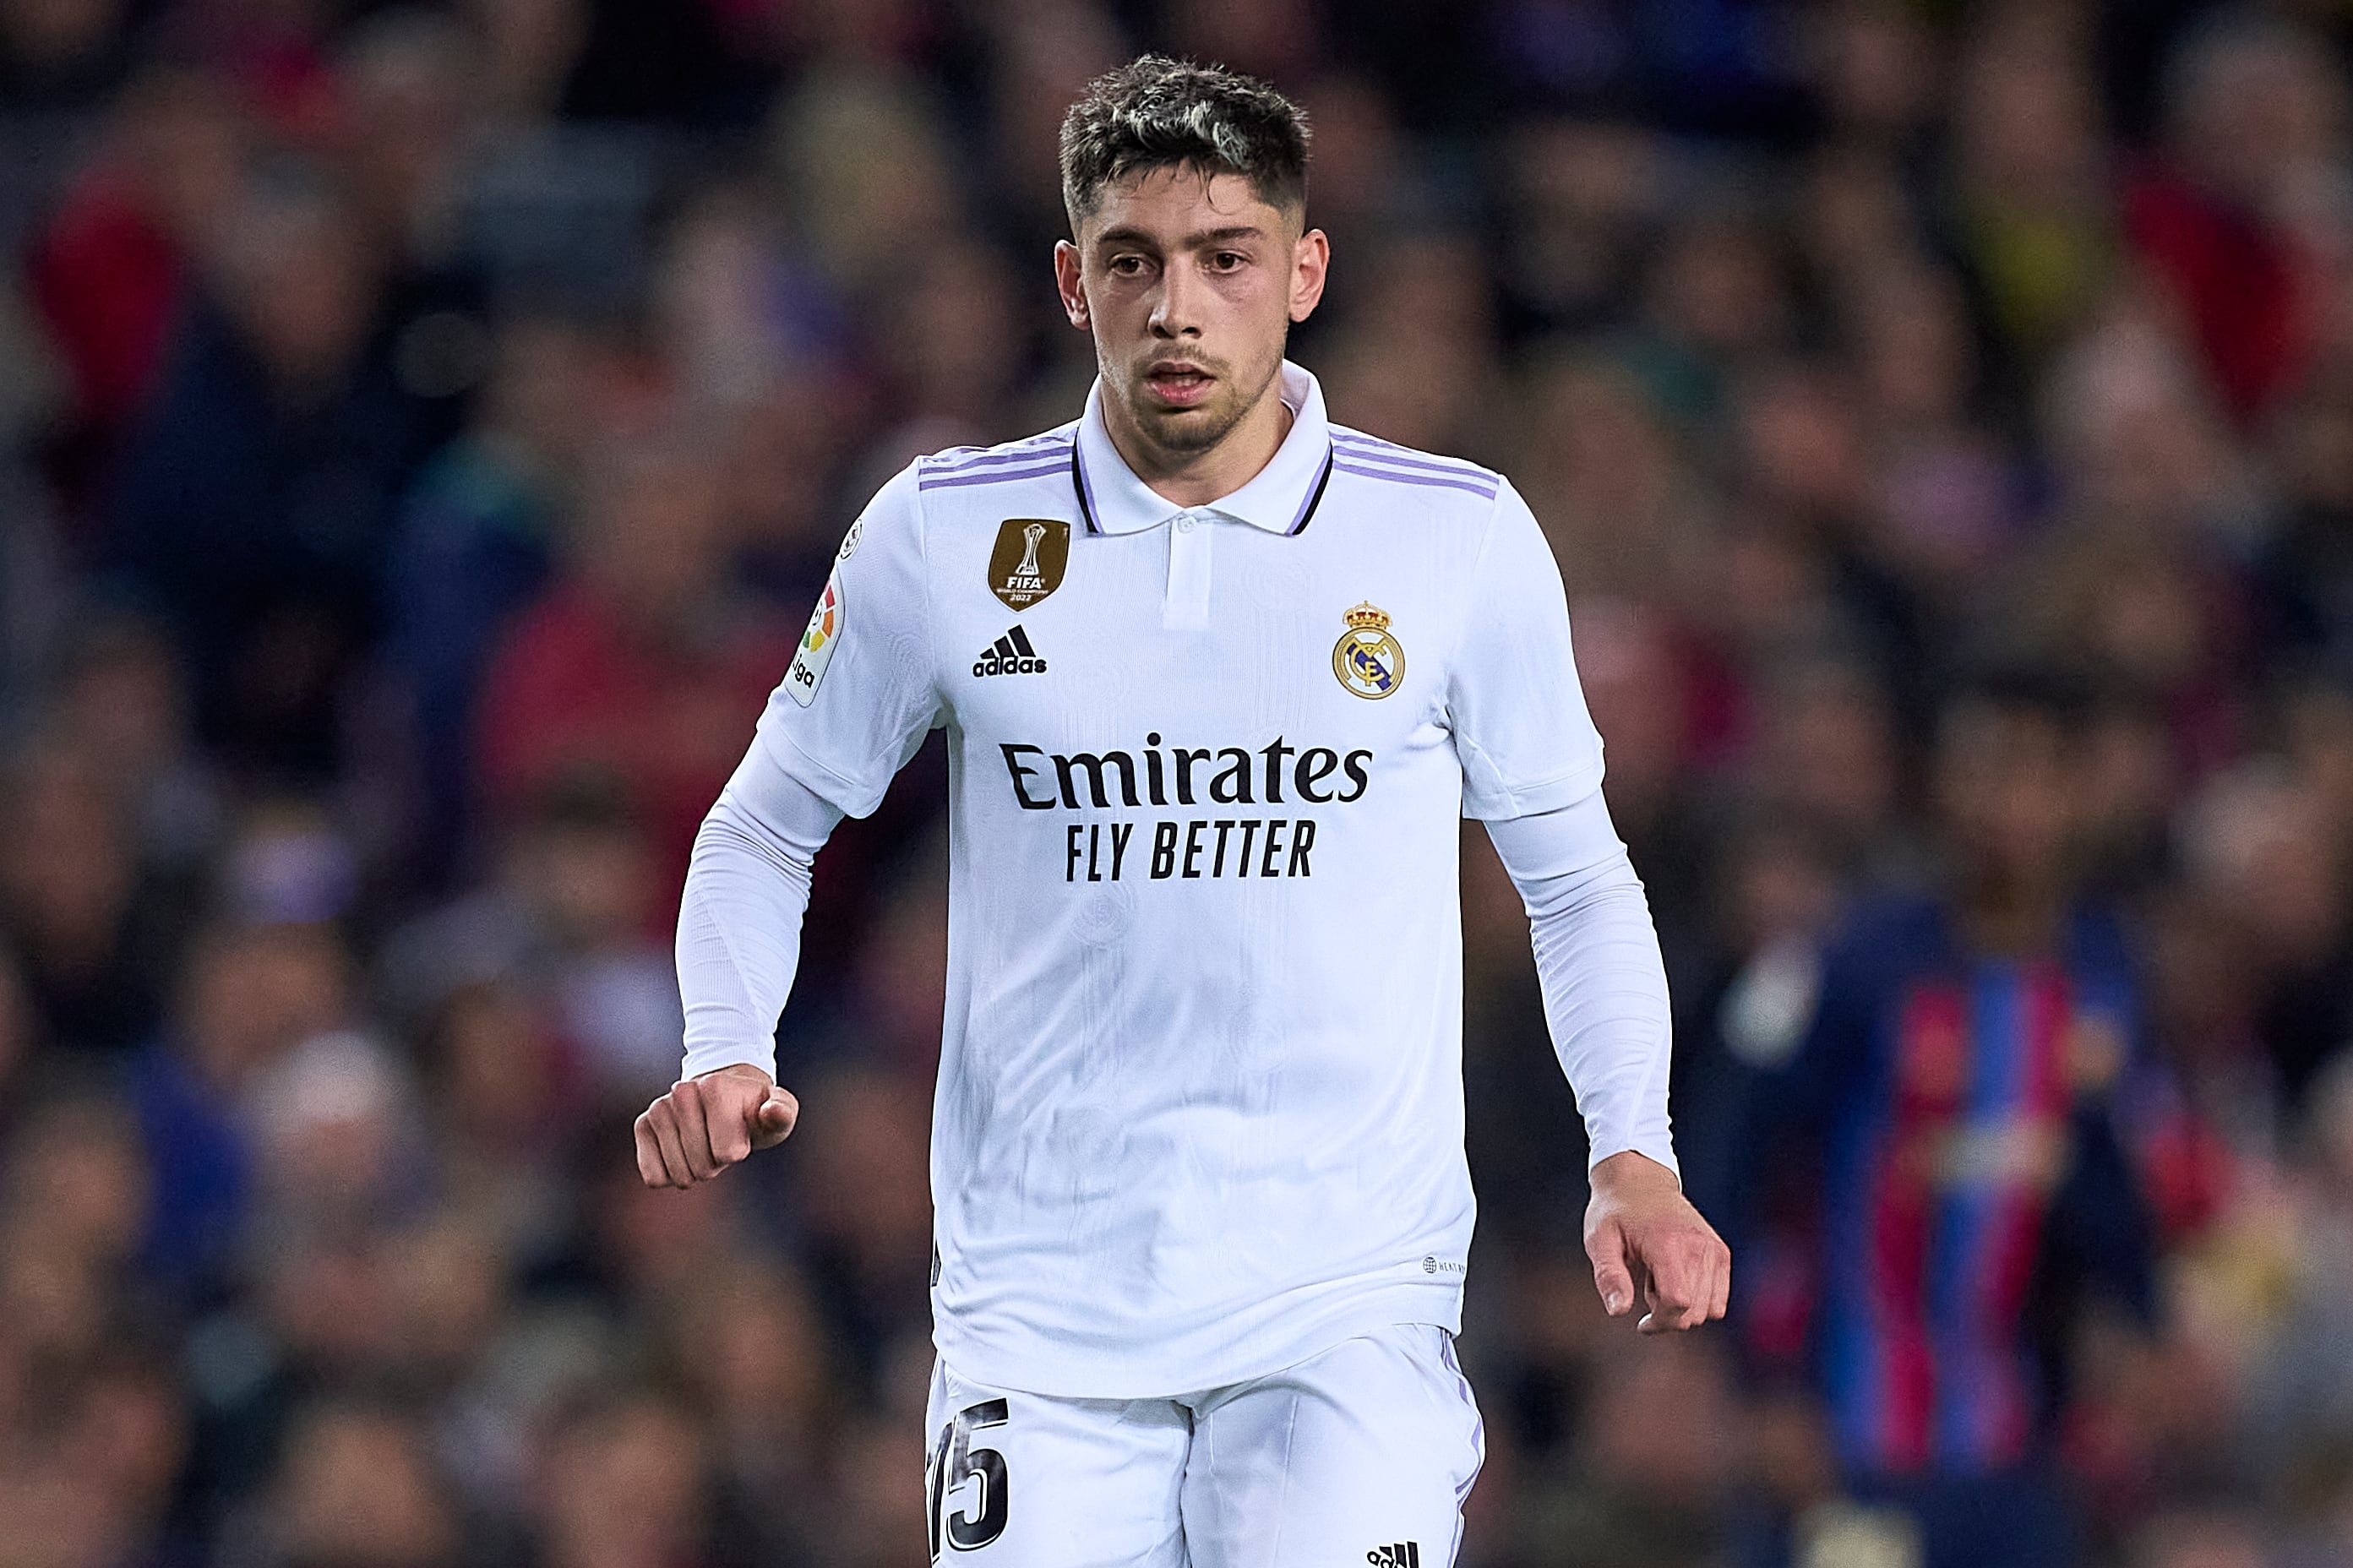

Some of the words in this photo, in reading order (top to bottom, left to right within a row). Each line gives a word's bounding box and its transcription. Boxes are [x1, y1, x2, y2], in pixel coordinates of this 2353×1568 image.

[1007, 577, 1042, 589] FIFA
[1010, 593, 1032, 602] 2022
[793, 653, 815, 689] iga
[972, 656, 1047, 678] adidas
[999, 732, 1373, 810] Emirates
[1066, 823, 1134, 882] FLY
[1150, 819, 1316, 880] BETTER
